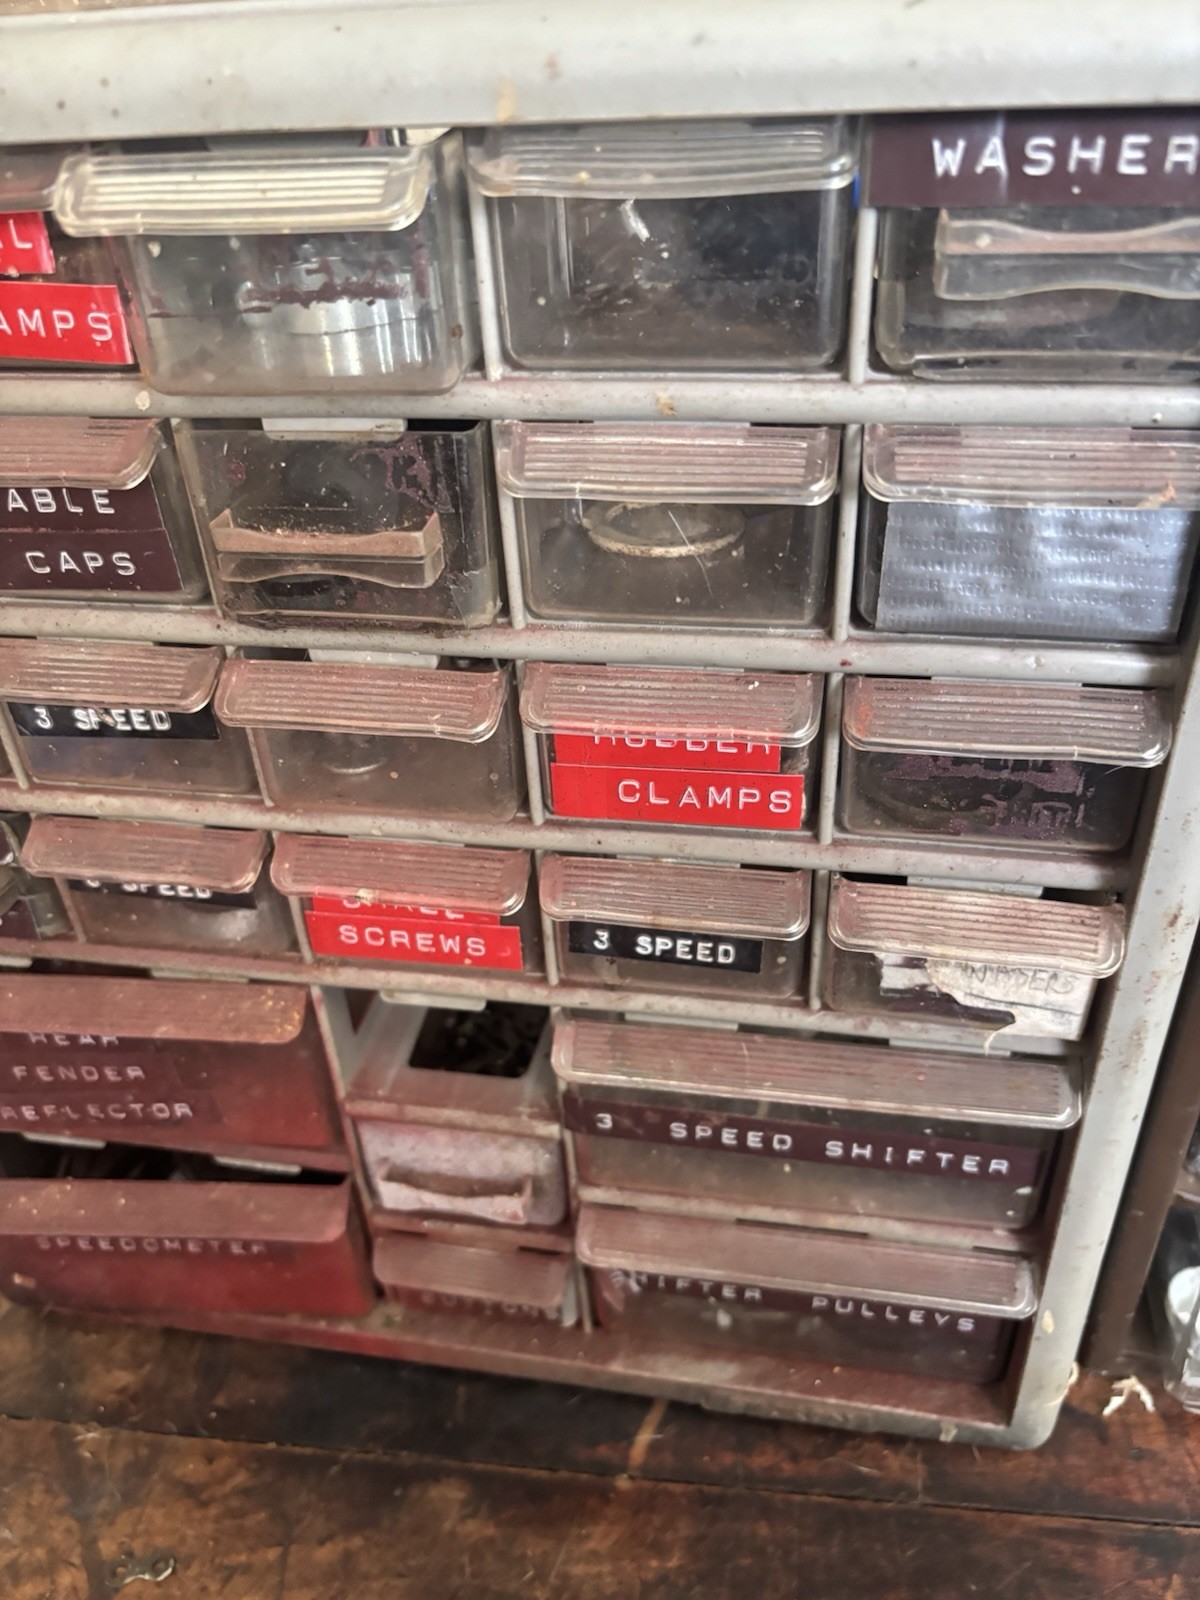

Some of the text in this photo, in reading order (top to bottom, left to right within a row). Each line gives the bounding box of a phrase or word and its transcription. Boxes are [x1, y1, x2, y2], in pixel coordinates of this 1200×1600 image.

[931, 134, 1200, 178] WASHER
[25, 551, 136, 576] CAPS
[34, 706, 53, 730] 3
[617, 779, 792, 813] CLAMPS
[338, 924, 486, 956] SCREWS
[592, 929, 737, 965] 3 SPEED
[12, 1065, 146, 1082] FENDER
[0, 1102, 194, 1121] REFLECTOR
[596, 1112, 1010, 1175] 3 SPEED SHIFTER
[811, 1296, 976, 1332] PULLEYS
